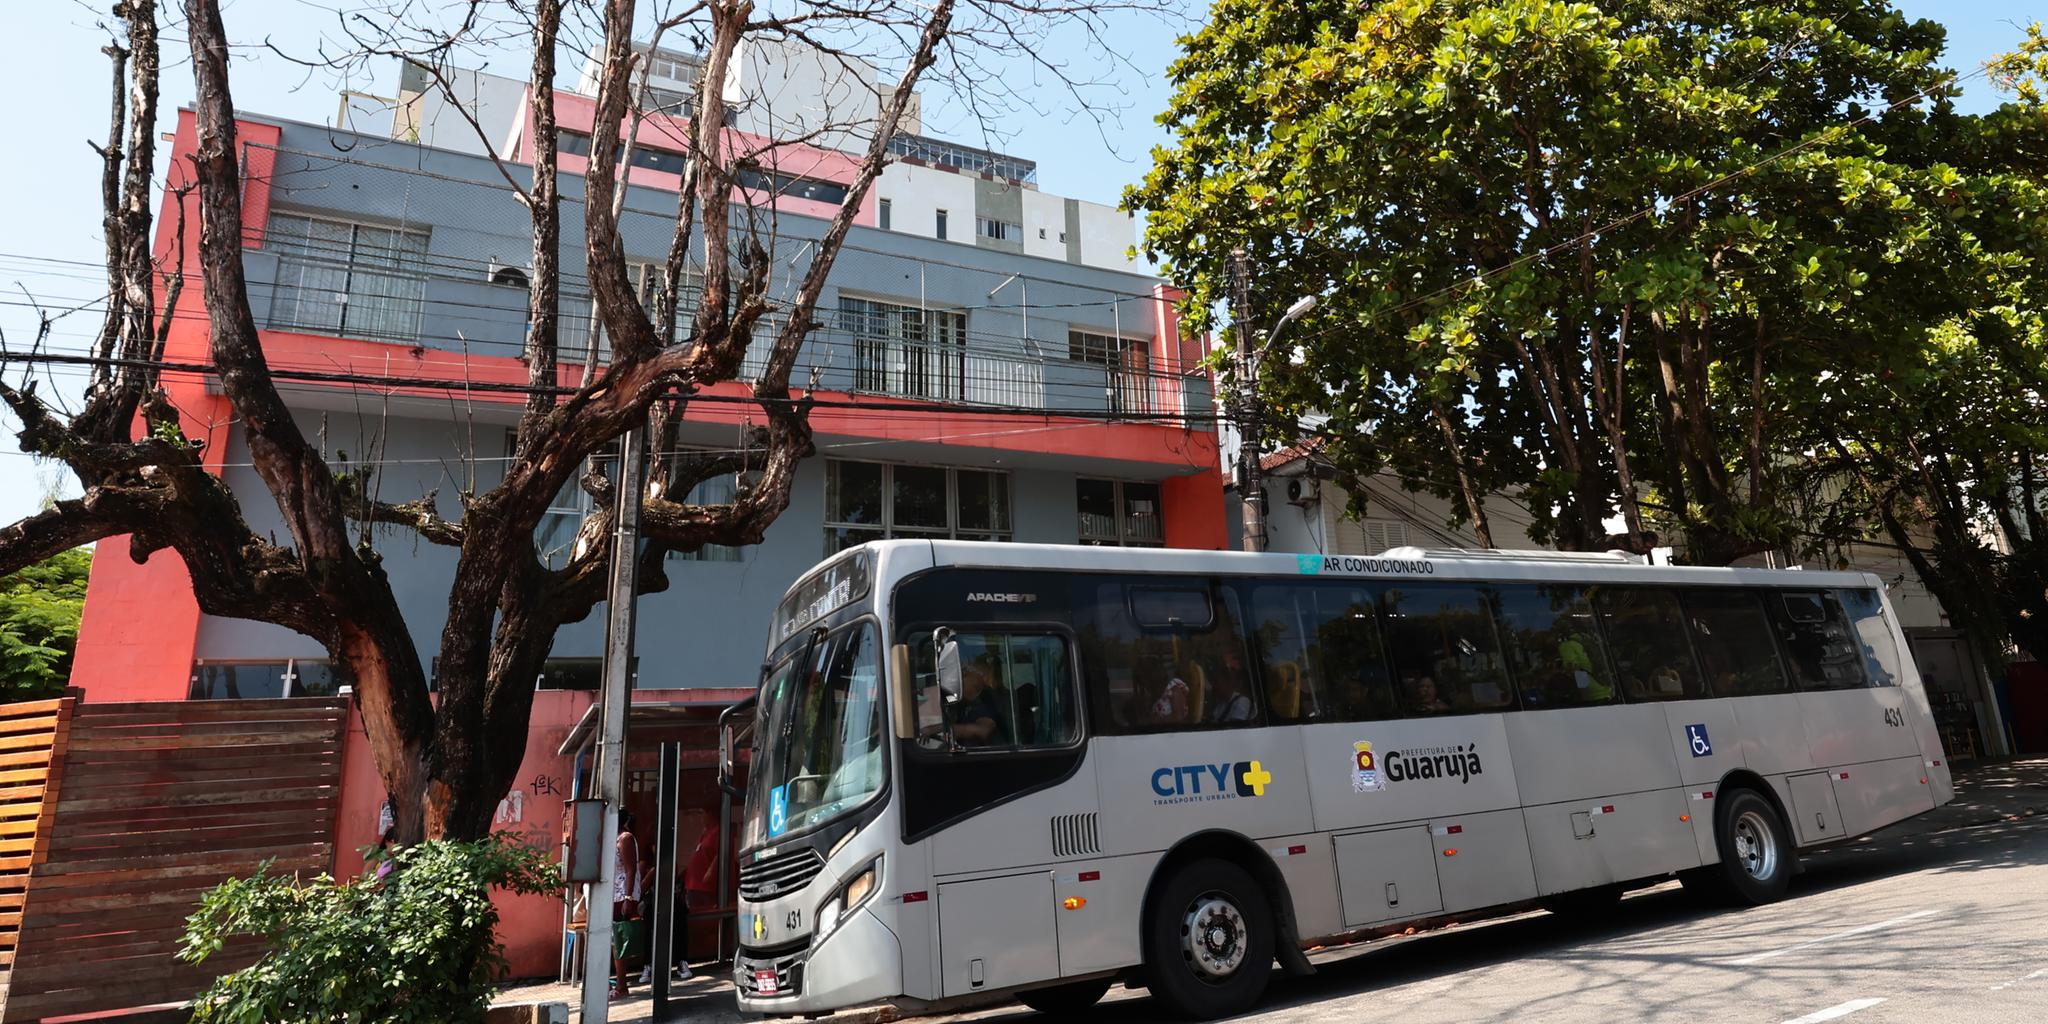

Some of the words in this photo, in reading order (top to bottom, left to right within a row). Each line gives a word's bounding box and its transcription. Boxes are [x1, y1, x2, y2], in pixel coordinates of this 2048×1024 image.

[1324, 558, 1342, 571] AR
[1344, 559, 1434, 574] CONDICIONADO
[1884, 707, 1904, 727] 431
[1400, 747, 1445, 756] PREFEITURA
[1447, 746, 1457, 754] DE
[1384, 742, 1482, 784] Guarujá
[1151, 763, 1231, 796] CITY
[1153, 796, 1203, 806] TRANSPORTE
[1206, 792, 1236, 801] URBANO
[786, 908, 801, 931] 431
